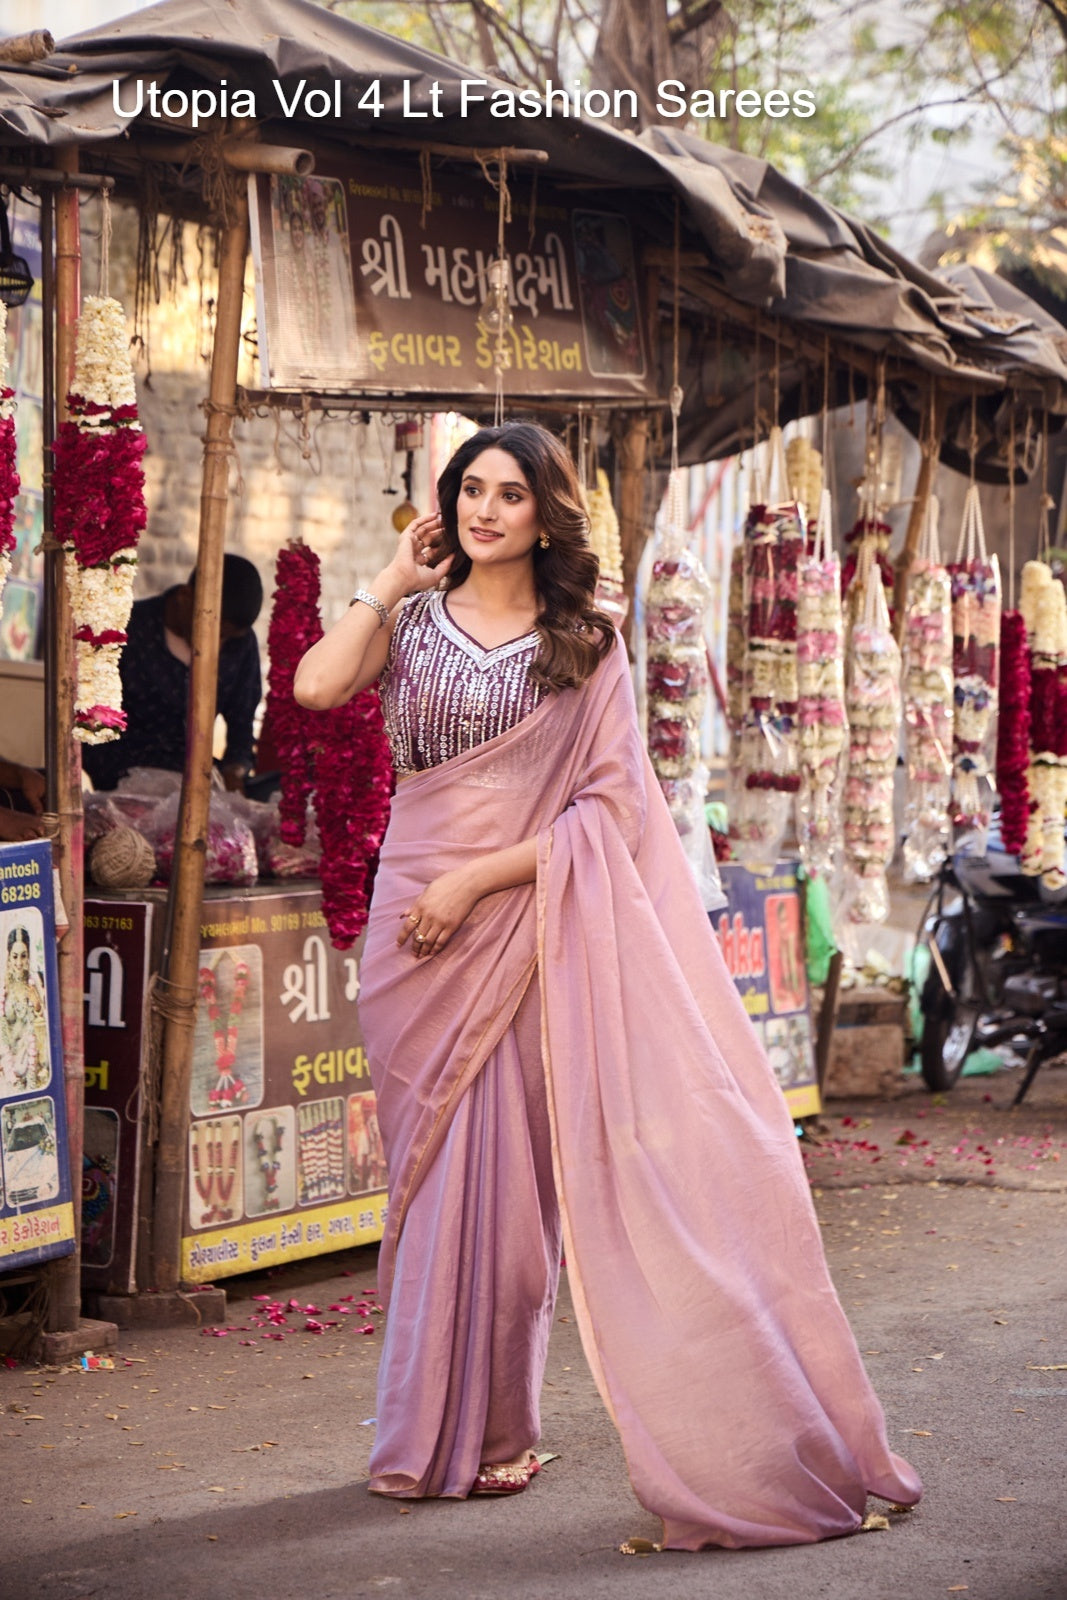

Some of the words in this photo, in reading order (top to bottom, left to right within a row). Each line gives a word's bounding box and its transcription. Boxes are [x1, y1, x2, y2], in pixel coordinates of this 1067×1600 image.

[360, 213, 412, 299] શ્રી
[1, 882, 41, 904] 68298
[279, 935, 331, 1024] શ્રી
